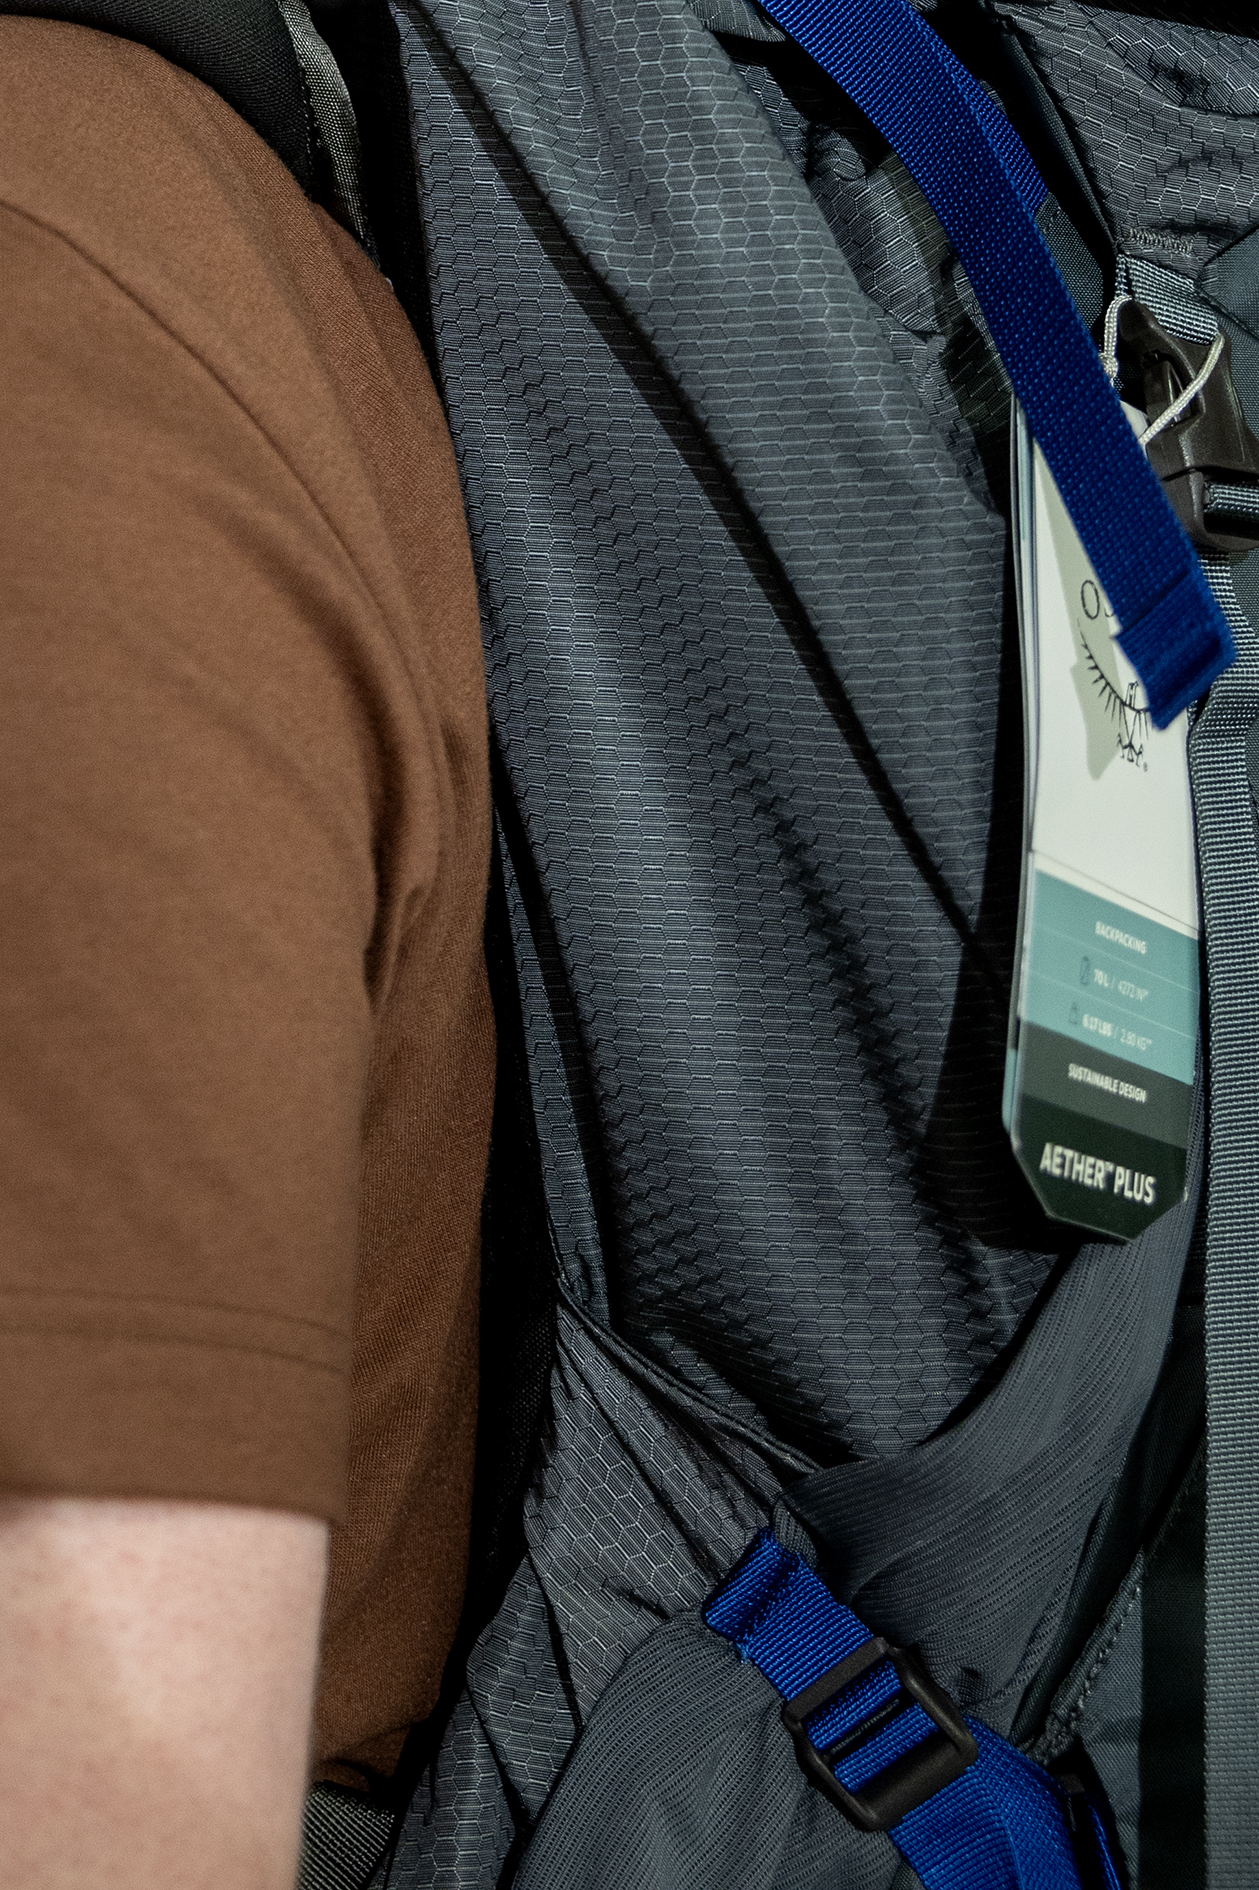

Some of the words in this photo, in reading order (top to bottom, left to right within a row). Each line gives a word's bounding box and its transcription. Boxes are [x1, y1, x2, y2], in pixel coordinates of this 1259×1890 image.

[1094, 920, 1147, 955] BACKPACKING
[1068, 1063, 1119, 1094] SUSTAINABLE
[1118, 1081, 1148, 1104] DESIGN
[1113, 1165, 1157, 1205] PLUS
